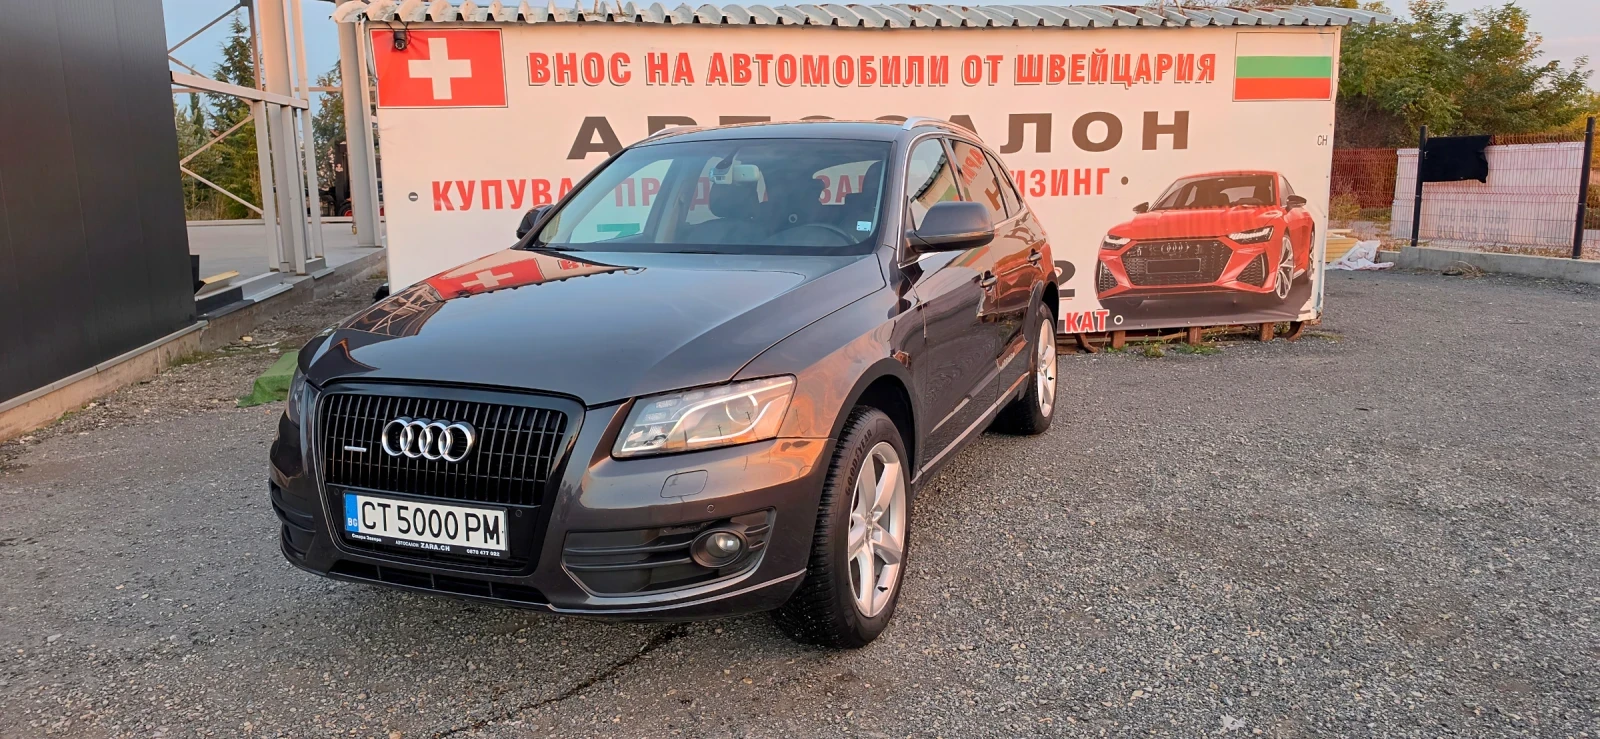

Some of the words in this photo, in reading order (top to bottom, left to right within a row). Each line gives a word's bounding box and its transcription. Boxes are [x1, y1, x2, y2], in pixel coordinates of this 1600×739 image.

[526, 52, 632, 86] ВНОС
[645, 52, 695, 86] НА
[706, 52, 949, 87] АВТОМОБИЛИ
[961, 54, 1004, 87] ОТ
[1014, 48, 1216, 90] ШВЕЙЦАРИЯ
[1064, 309, 1110, 334] КАТ
[845, 429, 872, 496] GOODYEAR
[347, 517, 358, 527] BG
[361, 501, 391, 532] CT
[397, 505, 459, 540] 5000
[465, 512, 500, 545] PM
[420, 542, 451, 552] ZARA.CH
